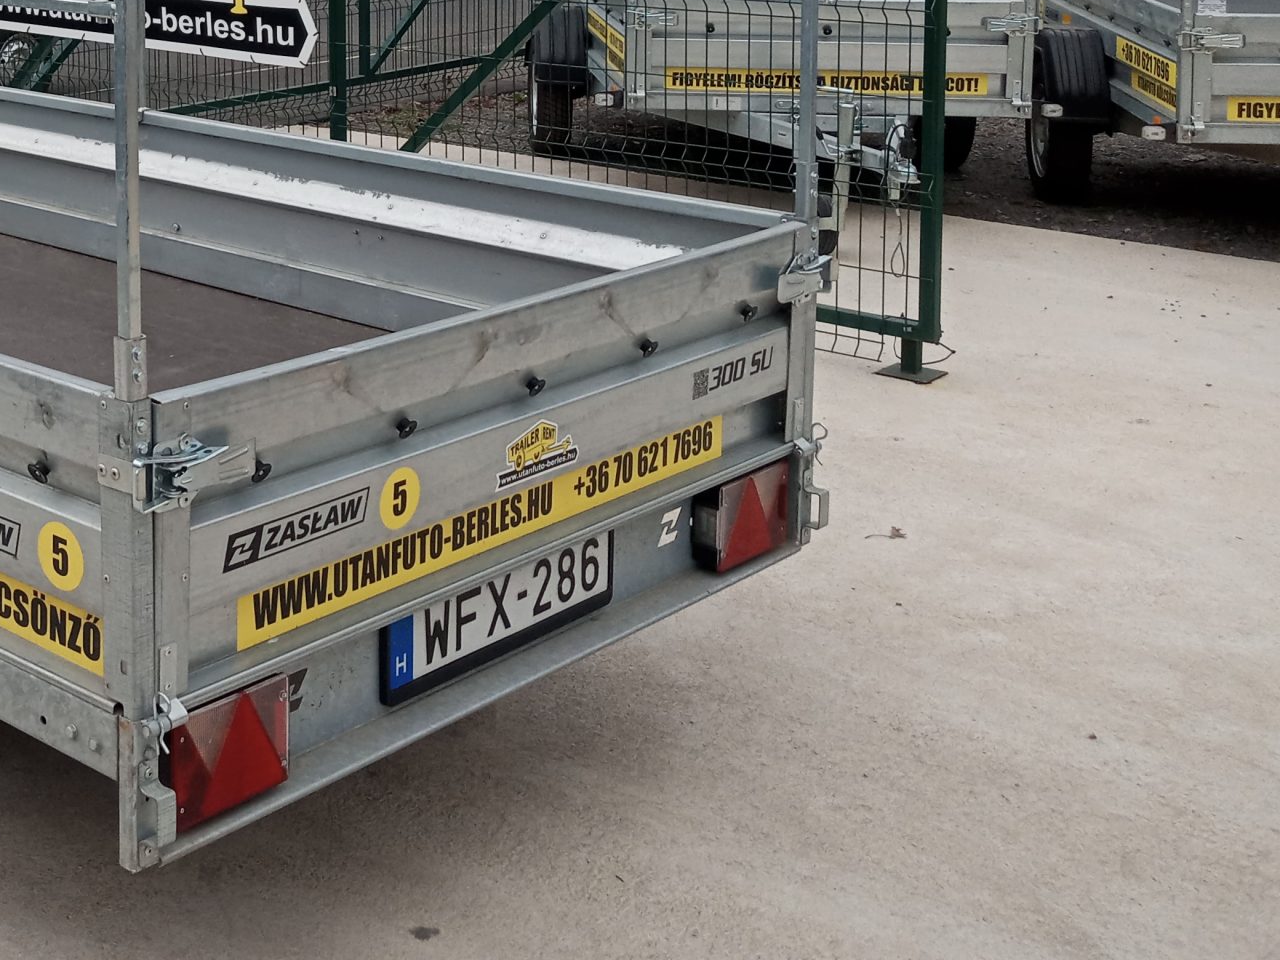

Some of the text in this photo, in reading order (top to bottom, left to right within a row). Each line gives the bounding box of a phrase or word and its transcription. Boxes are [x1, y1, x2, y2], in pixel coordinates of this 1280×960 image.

[1133, 47, 1141, 67] 70
[1142, 50, 1153, 74] 621
[672, 72, 742, 88] FIGYELEM!
[745, 71, 801, 89] RÖGZÍTS
[919, 76, 979, 93] LCOT!
[709, 346, 773, 391] 300 SU
[509, 425, 556, 457] TRAILER RENT
[392, 479, 407, 517] 5
[252, 420, 714, 630] WWW.UTANFUTO-BERLES.HU +36 70 621 7696
[264, 495, 364, 552] ZASŁAW
[51, 534, 69, 577] 5
[424, 537, 600, 666] WFX-286
[395, 652, 407, 678] H
